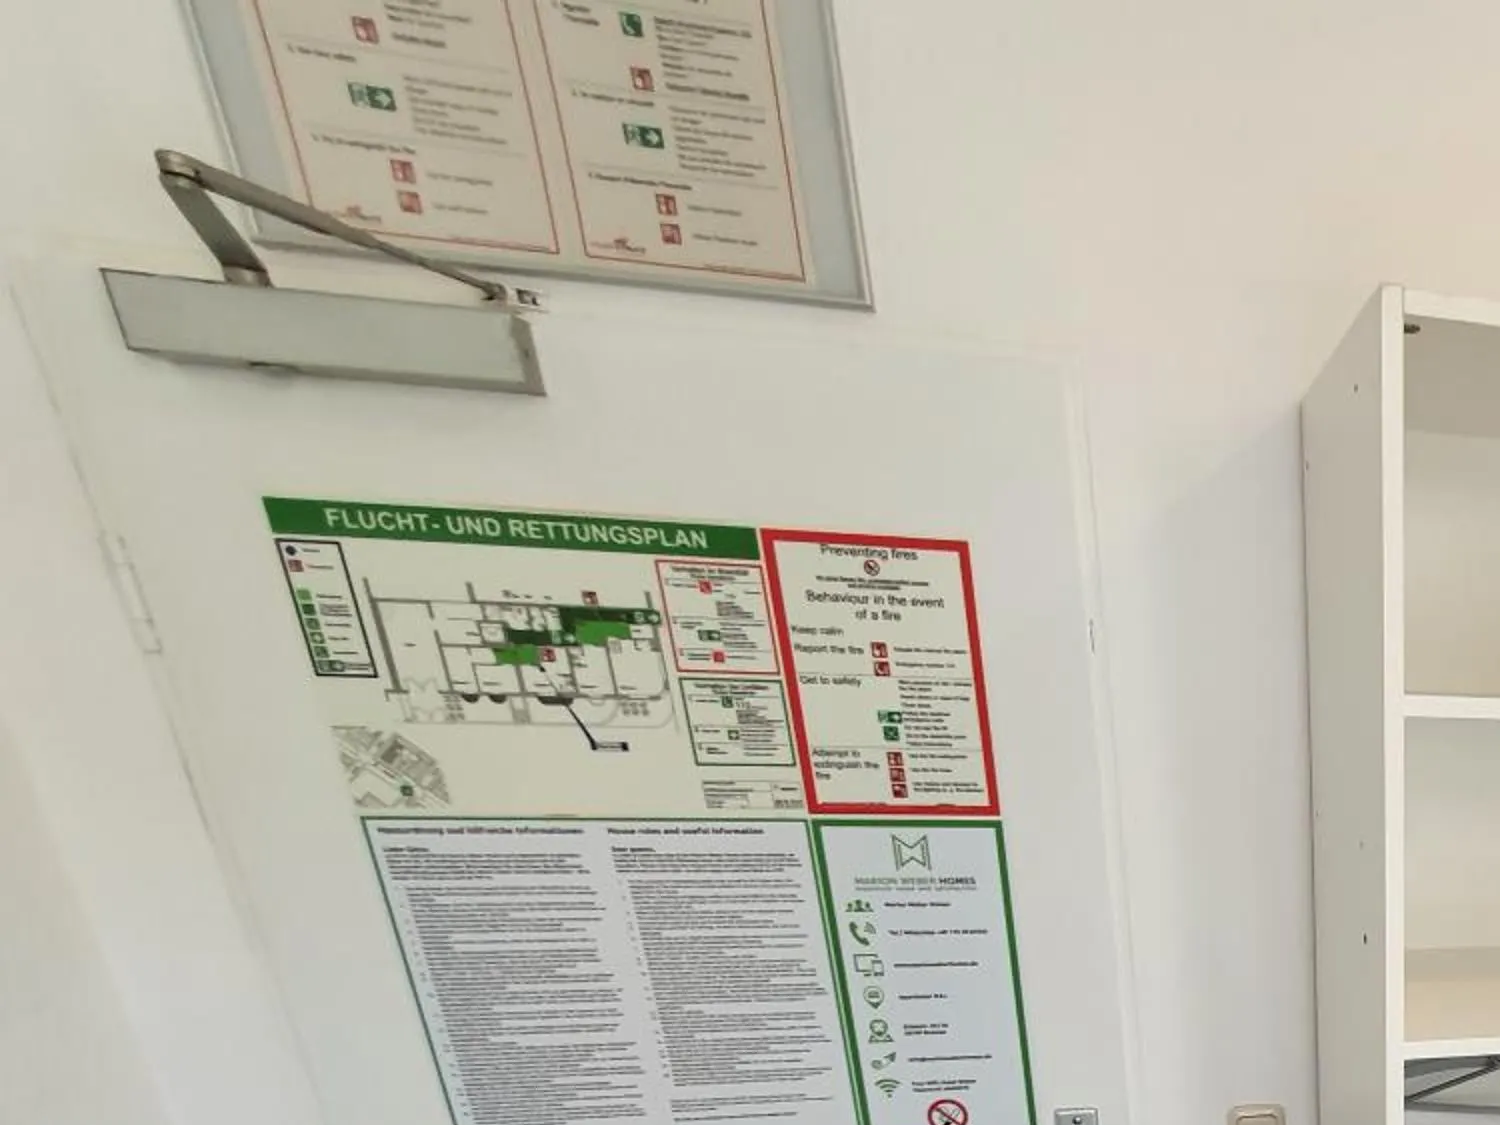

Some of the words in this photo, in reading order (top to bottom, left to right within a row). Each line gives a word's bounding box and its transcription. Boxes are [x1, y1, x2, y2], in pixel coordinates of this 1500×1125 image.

[323, 507, 440, 532] FLUCHT-
[446, 515, 501, 537] UND
[508, 518, 709, 549] RETTUNGSPLAN
[820, 543, 888, 561] Preventing
[891, 548, 918, 561] fires
[805, 589, 869, 605] Behaviour
[873, 595, 885, 605] in
[888, 595, 907, 607] the
[911, 597, 945, 609] event
[855, 609, 867, 620] of
[881, 610, 901, 621] fire
